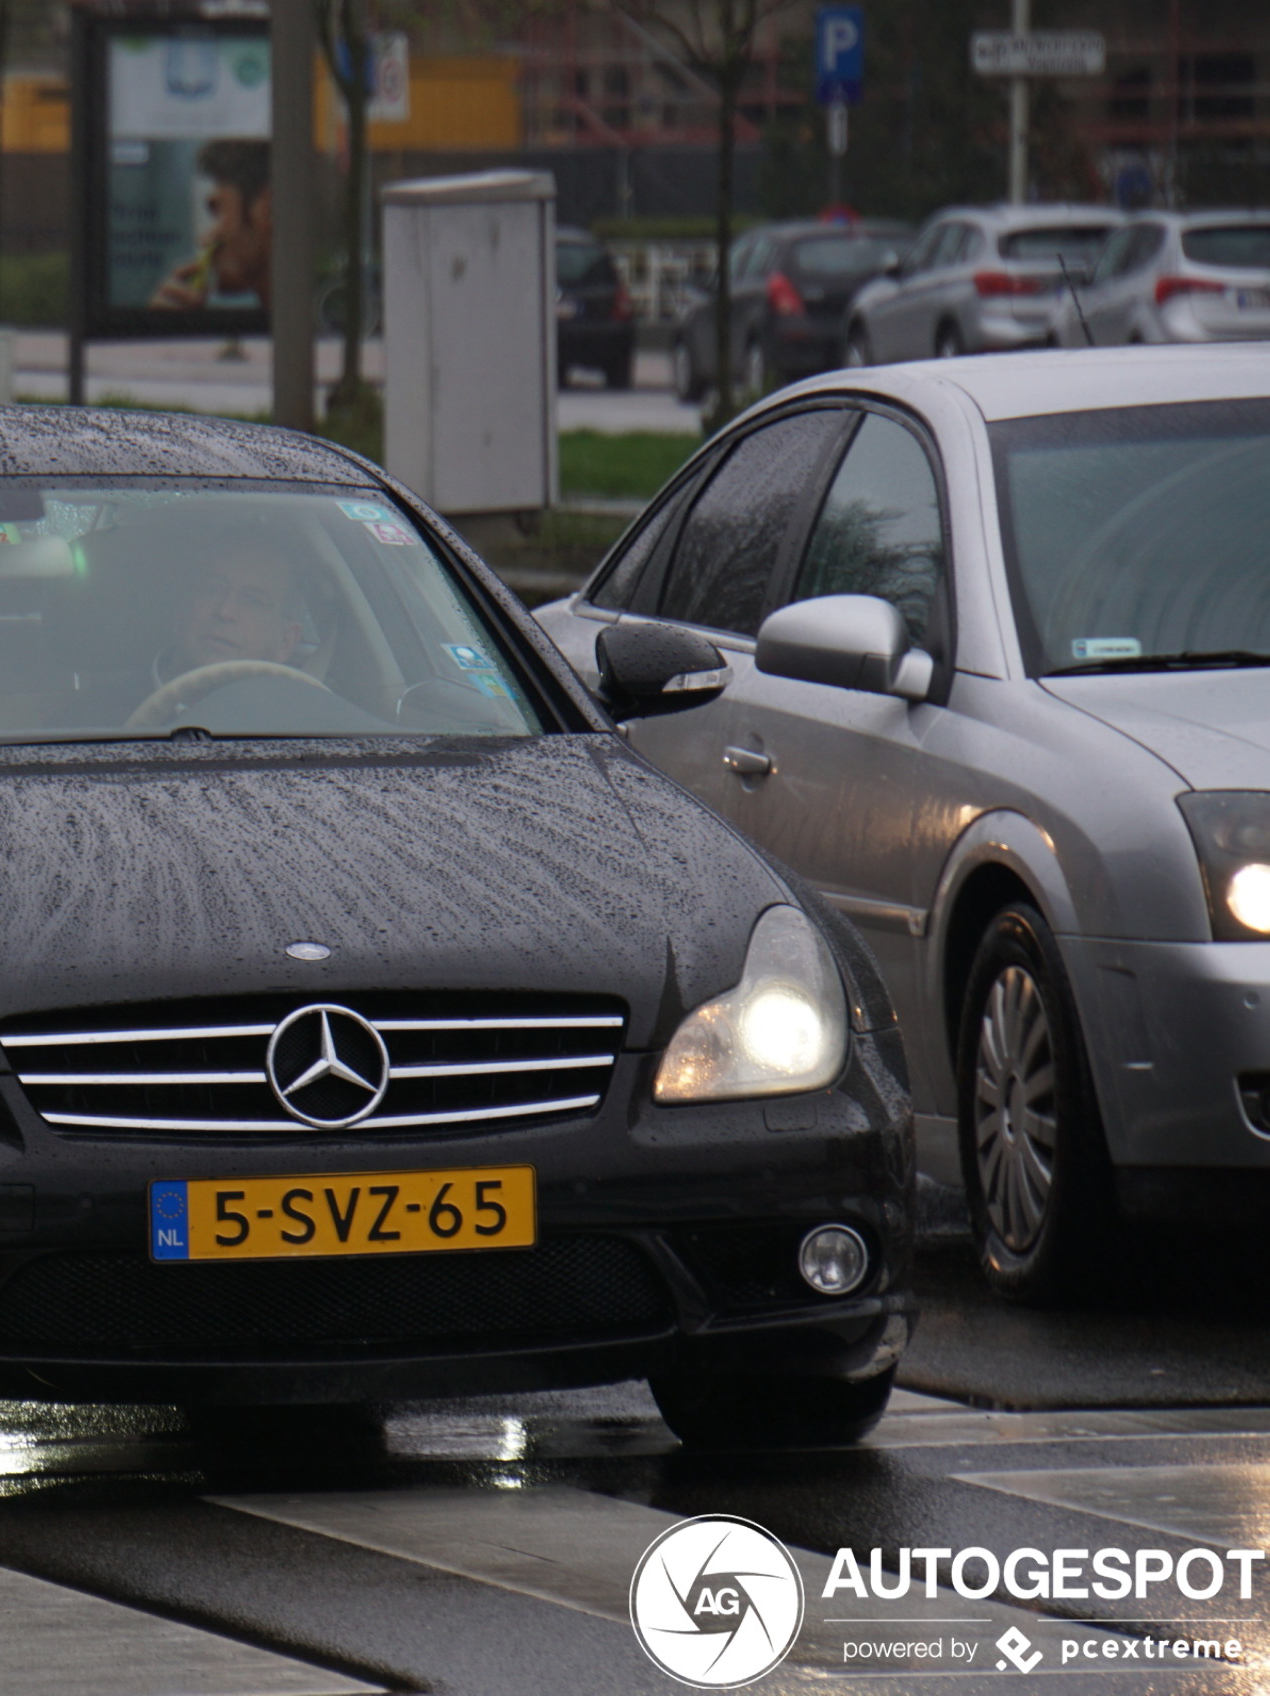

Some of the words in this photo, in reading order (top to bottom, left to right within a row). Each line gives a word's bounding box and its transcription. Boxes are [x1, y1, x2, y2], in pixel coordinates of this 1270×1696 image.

[824, 17, 858, 71] P
[158, 1230, 184, 1246] NL
[216, 1181, 507, 1247] 5-SVZ-65
